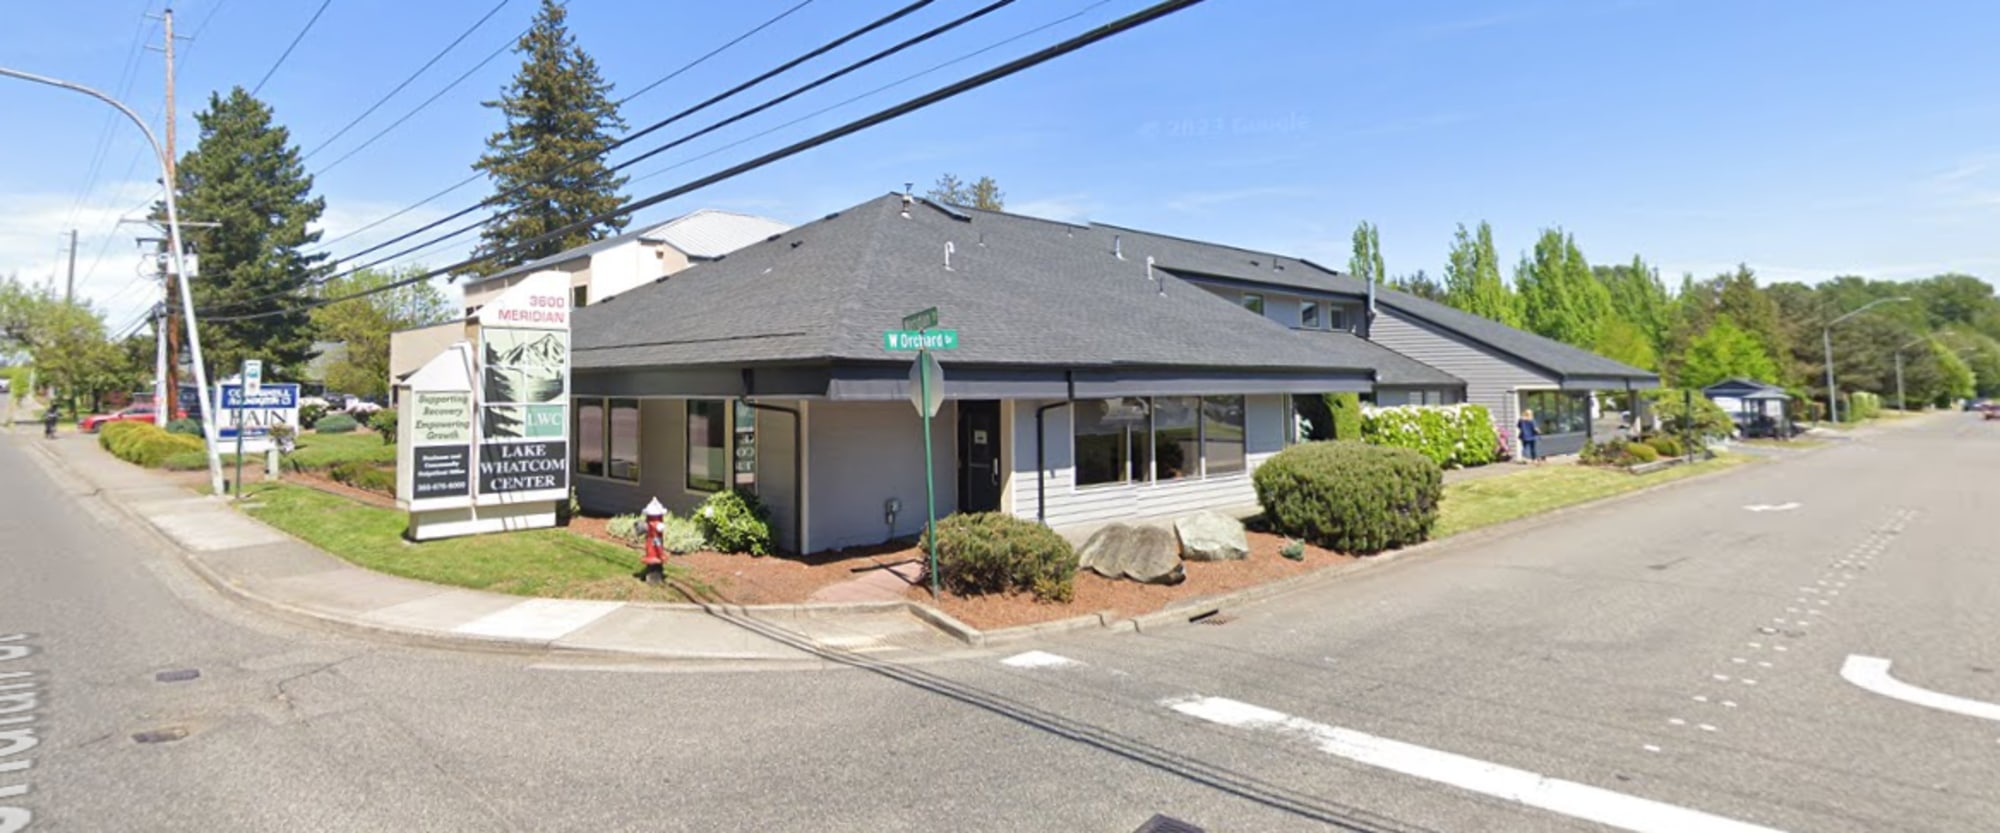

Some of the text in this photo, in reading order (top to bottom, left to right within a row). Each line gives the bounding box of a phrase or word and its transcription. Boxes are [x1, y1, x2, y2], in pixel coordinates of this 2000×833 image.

[529, 295, 564, 308] 3600
[498, 308, 565, 323] MERIDIAN
[900, 333, 943, 348] Orchard
[418, 394, 468, 405] Supporting
[423, 406, 463, 416] Recovery
[415, 420, 470, 430] Empowering
[527, 412, 562, 426] LWC
[426, 430, 459, 440] Growth
[502, 444, 547, 459] LAKE
[480, 458, 566, 475] WHATCOM
[490, 474, 556, 491] CENTER
